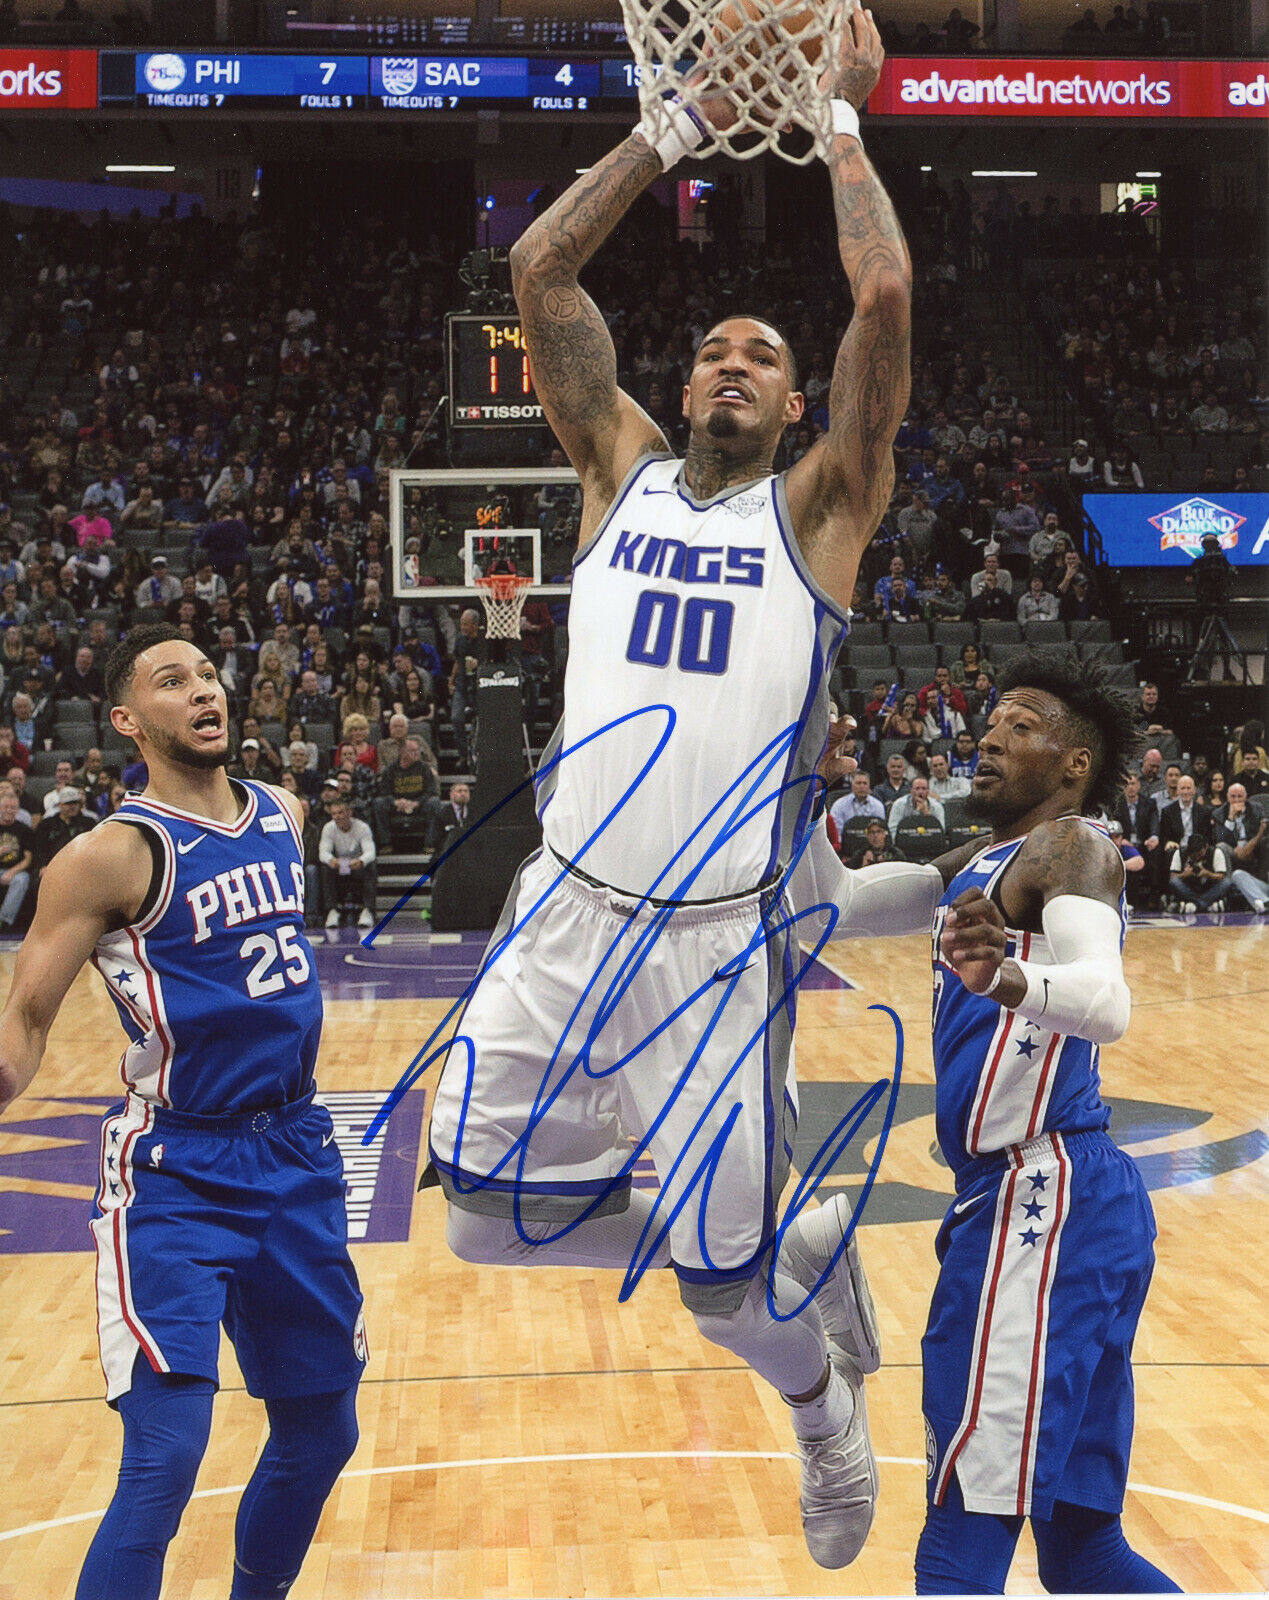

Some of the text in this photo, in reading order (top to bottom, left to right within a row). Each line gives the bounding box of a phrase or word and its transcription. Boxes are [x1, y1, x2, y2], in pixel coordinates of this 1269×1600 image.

[0, 62, 62, 96] orks
[195, 60, 240, 84] PHI
[319, 62, 337, 85] 7
[424, 62, 481, 87] SAC
[555, 64, 573, 87] 4
[900, 71, 1171, 106] advantelnetworks
[1228, 74, 1269, 106] ad
[147, 94, 225, 107] TIMEOUTS 7
[300, 95, 353, 108] FOULS 1
[381, 96, 459, 109] TIMEOUTS 7
[533, 97, 588, 109] FOULS 2
[480, 405, 543, 419] TISSOT
[1162, 516, 1235, 533] DIAMOND
[608, 530, 766, 588] KINGS
[625, 588, 736, 677] 00
[239, 924, 311, 1000] 25
